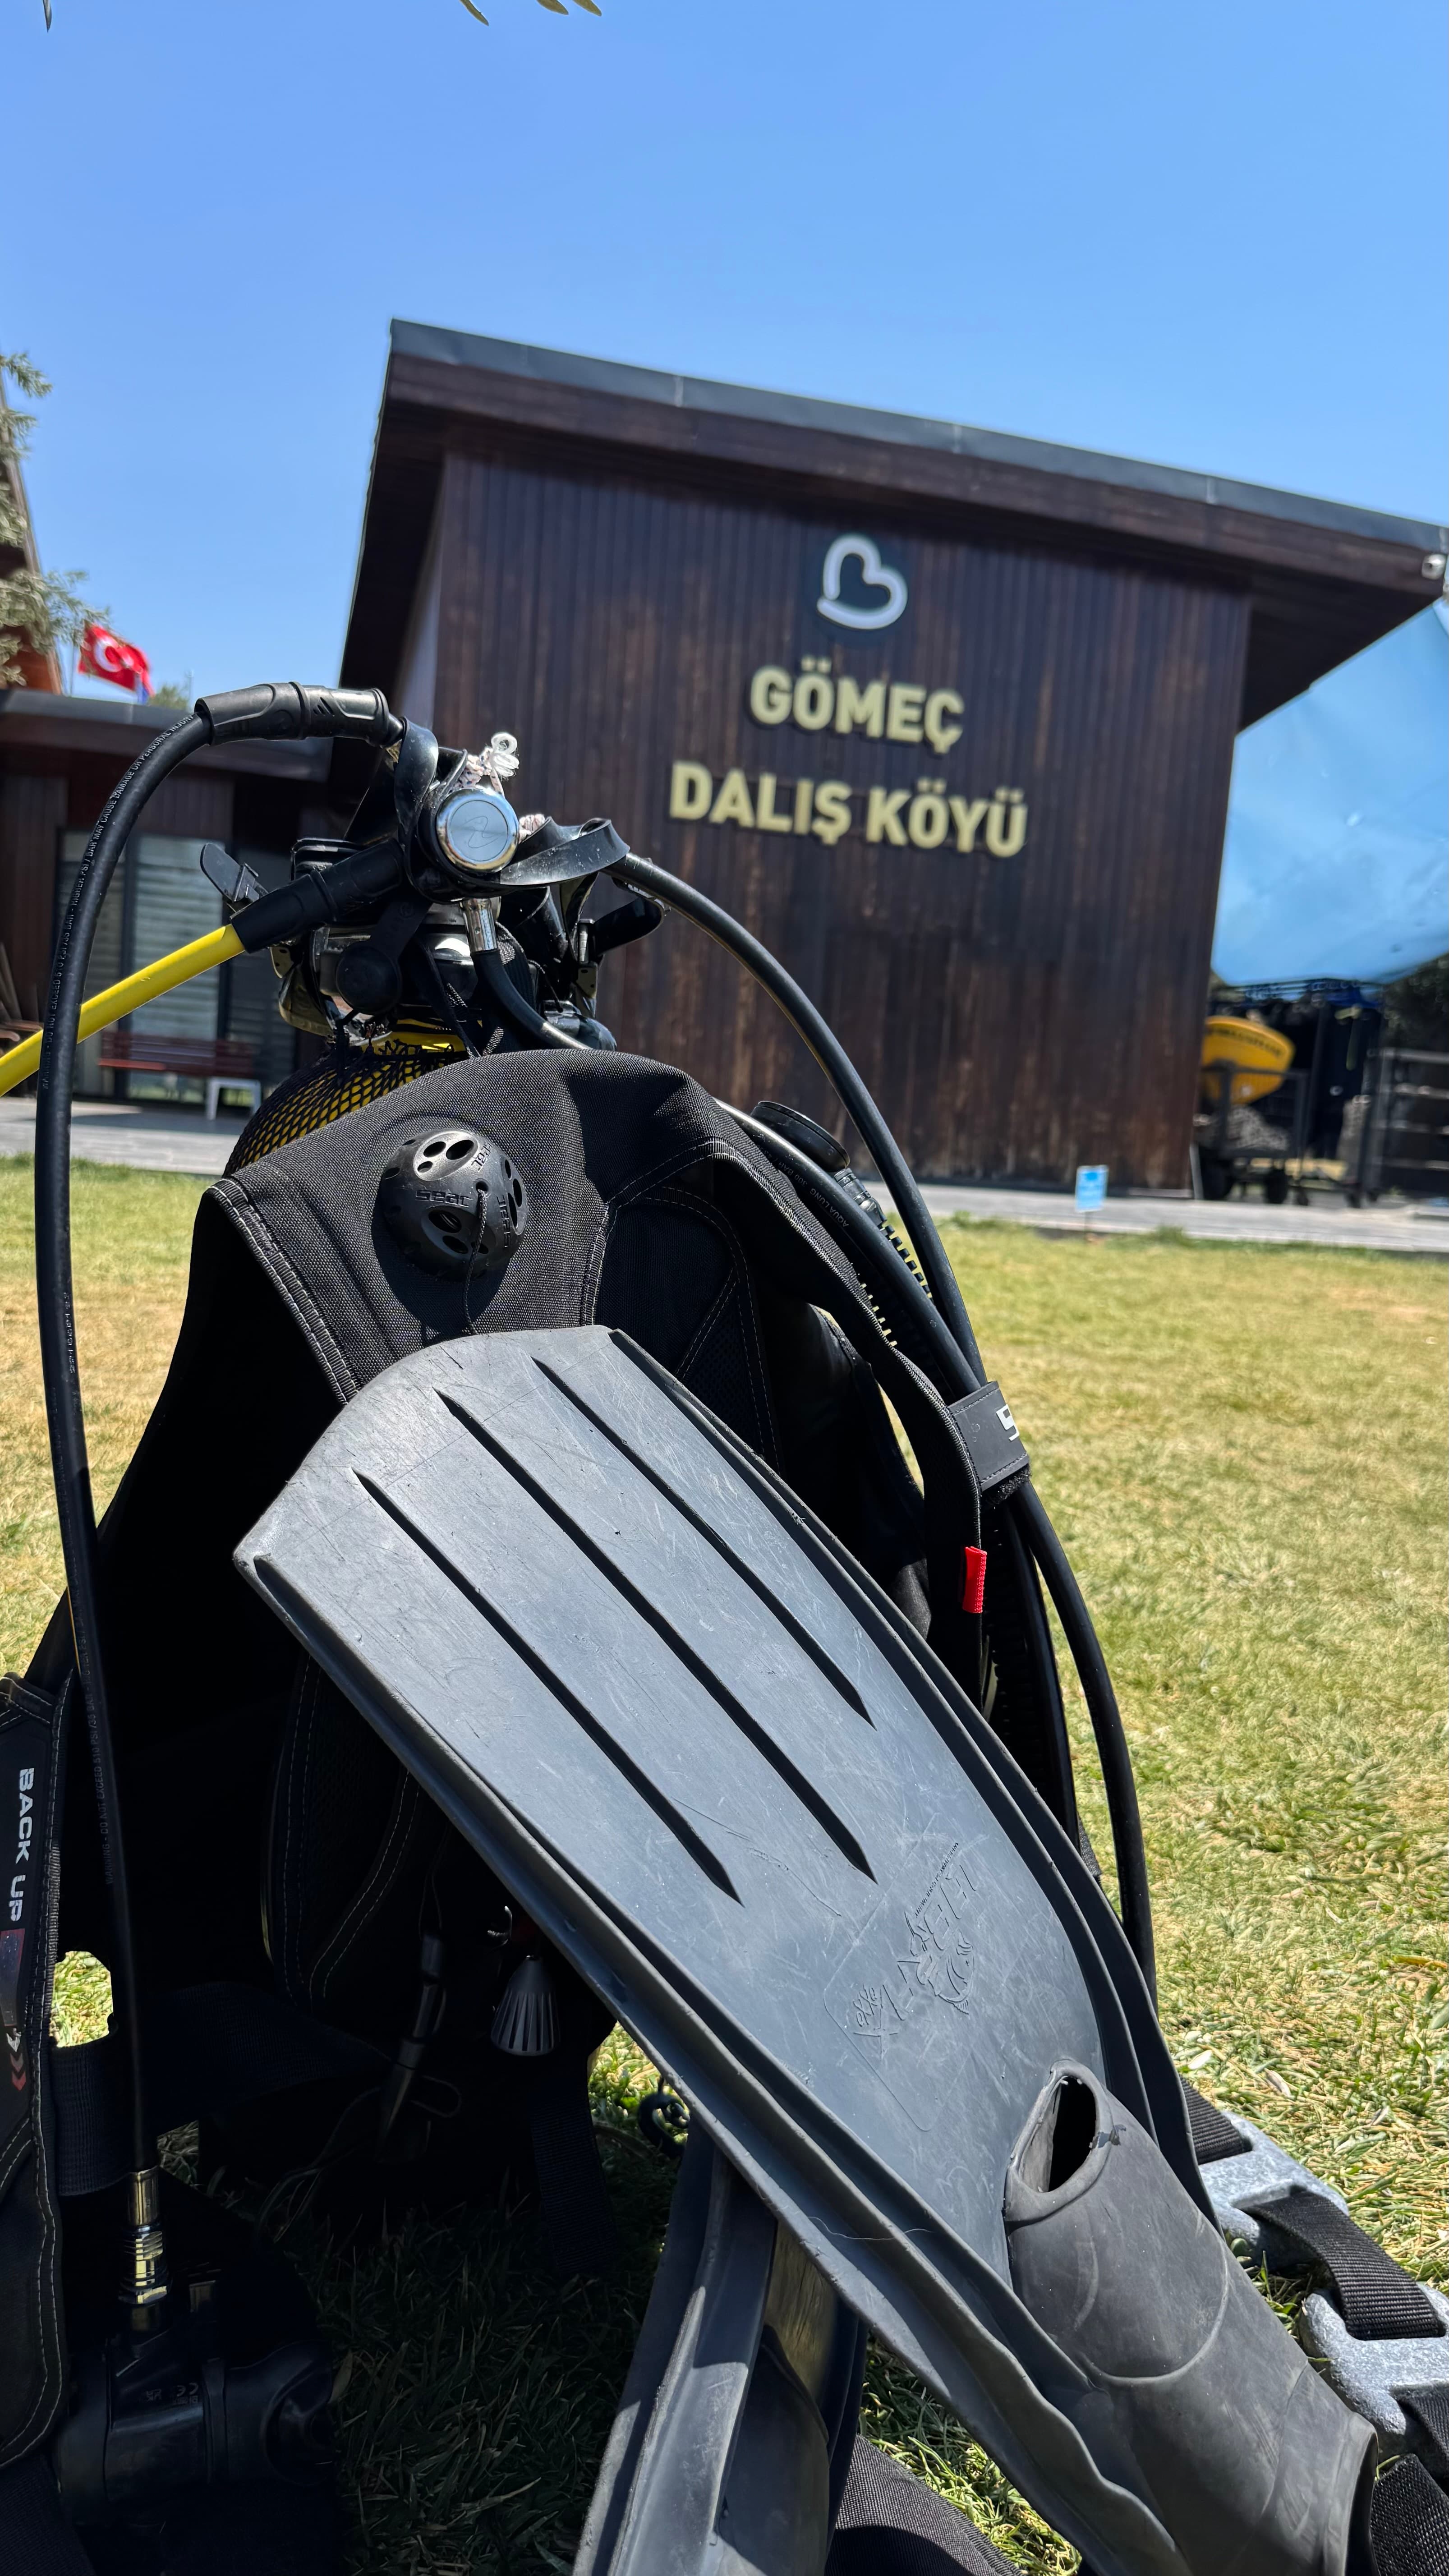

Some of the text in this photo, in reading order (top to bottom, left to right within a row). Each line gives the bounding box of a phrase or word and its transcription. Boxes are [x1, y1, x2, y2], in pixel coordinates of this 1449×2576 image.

[749, 654, 965, 754] GÖMEÇ
[669, 760, 1028, 858] DALIŞ KÖYÜ
[47, 1014, 55, 1029] NOT
[51, 980, 61, 1010] EXCEED
[72, 878, 85, 906] HIGHER
[81, 864, 89, 876] PSI
[87, 840, 97, 857] BAR
[93, 824, 105, 840] MAY
[101, 800, 117, 823] CAUSE
[113, 771, 135, 799] DAMAGE
[132, 759, 143, 771] OR
[139, 731, 171, 761] PERSONAL
[170, 714, 194, 732] INJURY
[778, 1161, 795, 1178] BAR
[794, 1174, 808, 1188] 300
[810, 1188, 831, 1209] LUNG
[829, 1208, 850, 1228] AQUA
[91, 1731, 99, 1745] PSI
[92, 1748, 101, 1763] 510
[94, 1766, 105, 1799] EXCEED
[97, 1802, 108, 1819] NOT
[100, 1822, 109, 1834] DO
[9, 1767, 35, 1922] BACK UP
[102, 1843, 114, 1884] WARNING
